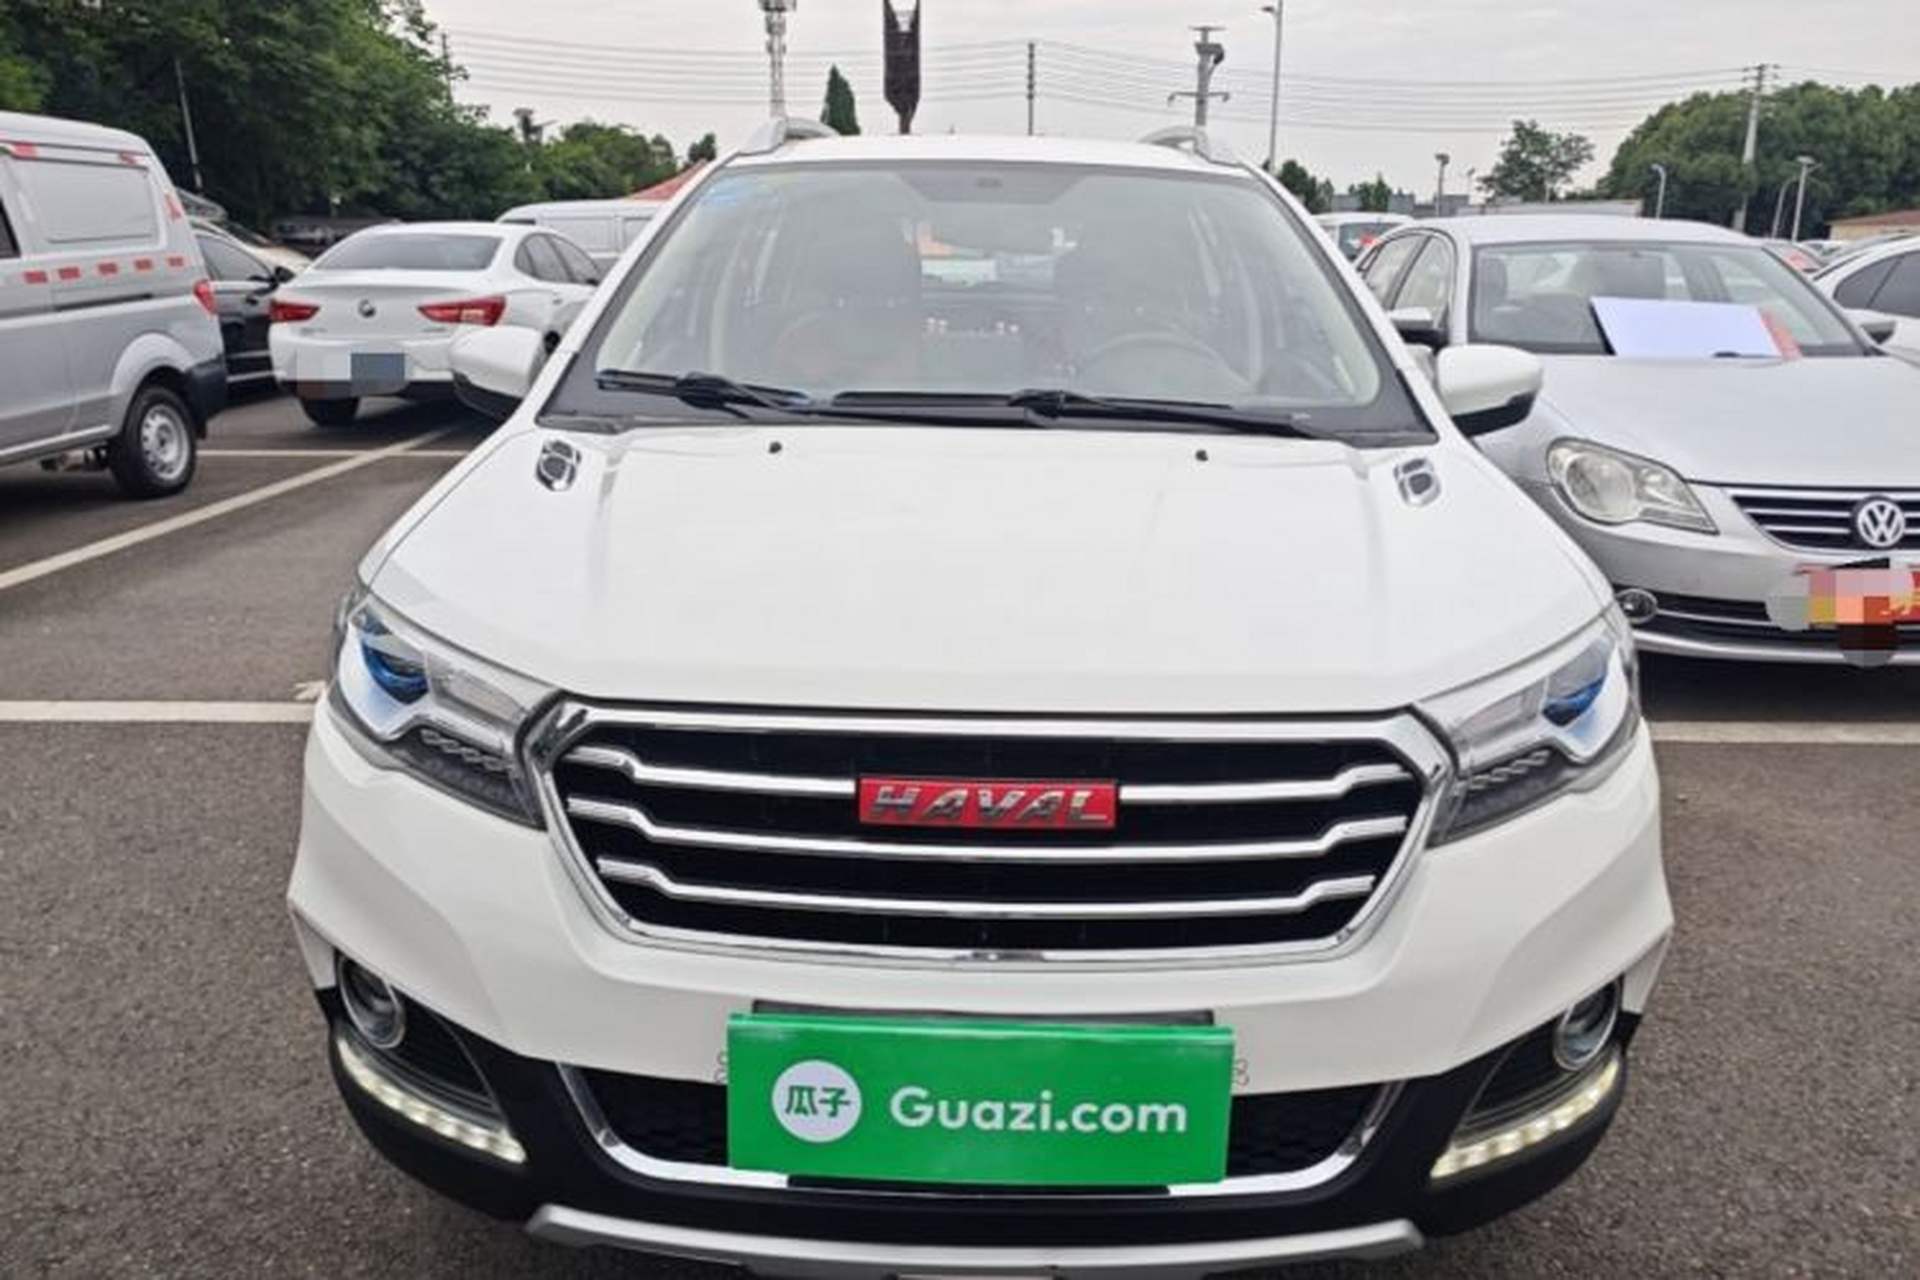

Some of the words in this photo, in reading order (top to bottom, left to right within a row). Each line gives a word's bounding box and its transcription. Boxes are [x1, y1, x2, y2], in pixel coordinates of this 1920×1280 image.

[1858, 501, 1905, 547] VW
[870, 785, 1107, 821] HAVAL
[784, 1084, 851, 1118] 瓜子
[889, 1087, 1187, 1133] Guazi.com
